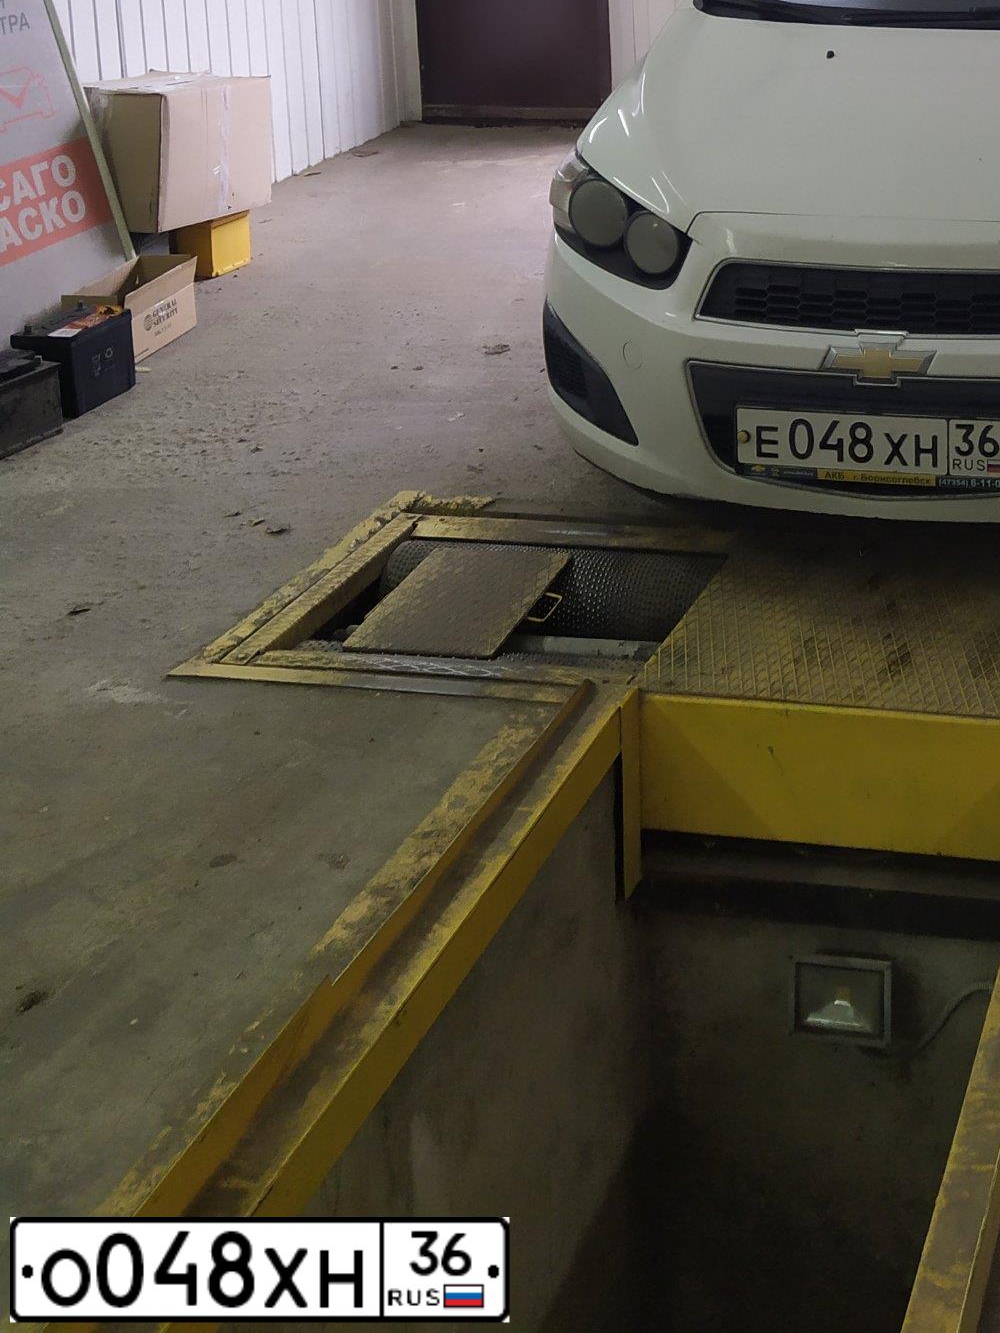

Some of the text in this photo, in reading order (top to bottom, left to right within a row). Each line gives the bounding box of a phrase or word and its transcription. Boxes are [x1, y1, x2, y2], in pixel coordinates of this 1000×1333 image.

[954, 424, 1000, 458] 36
[952, 458, 986, 471] RUS
[824, 470, 844, 480] АКБ
